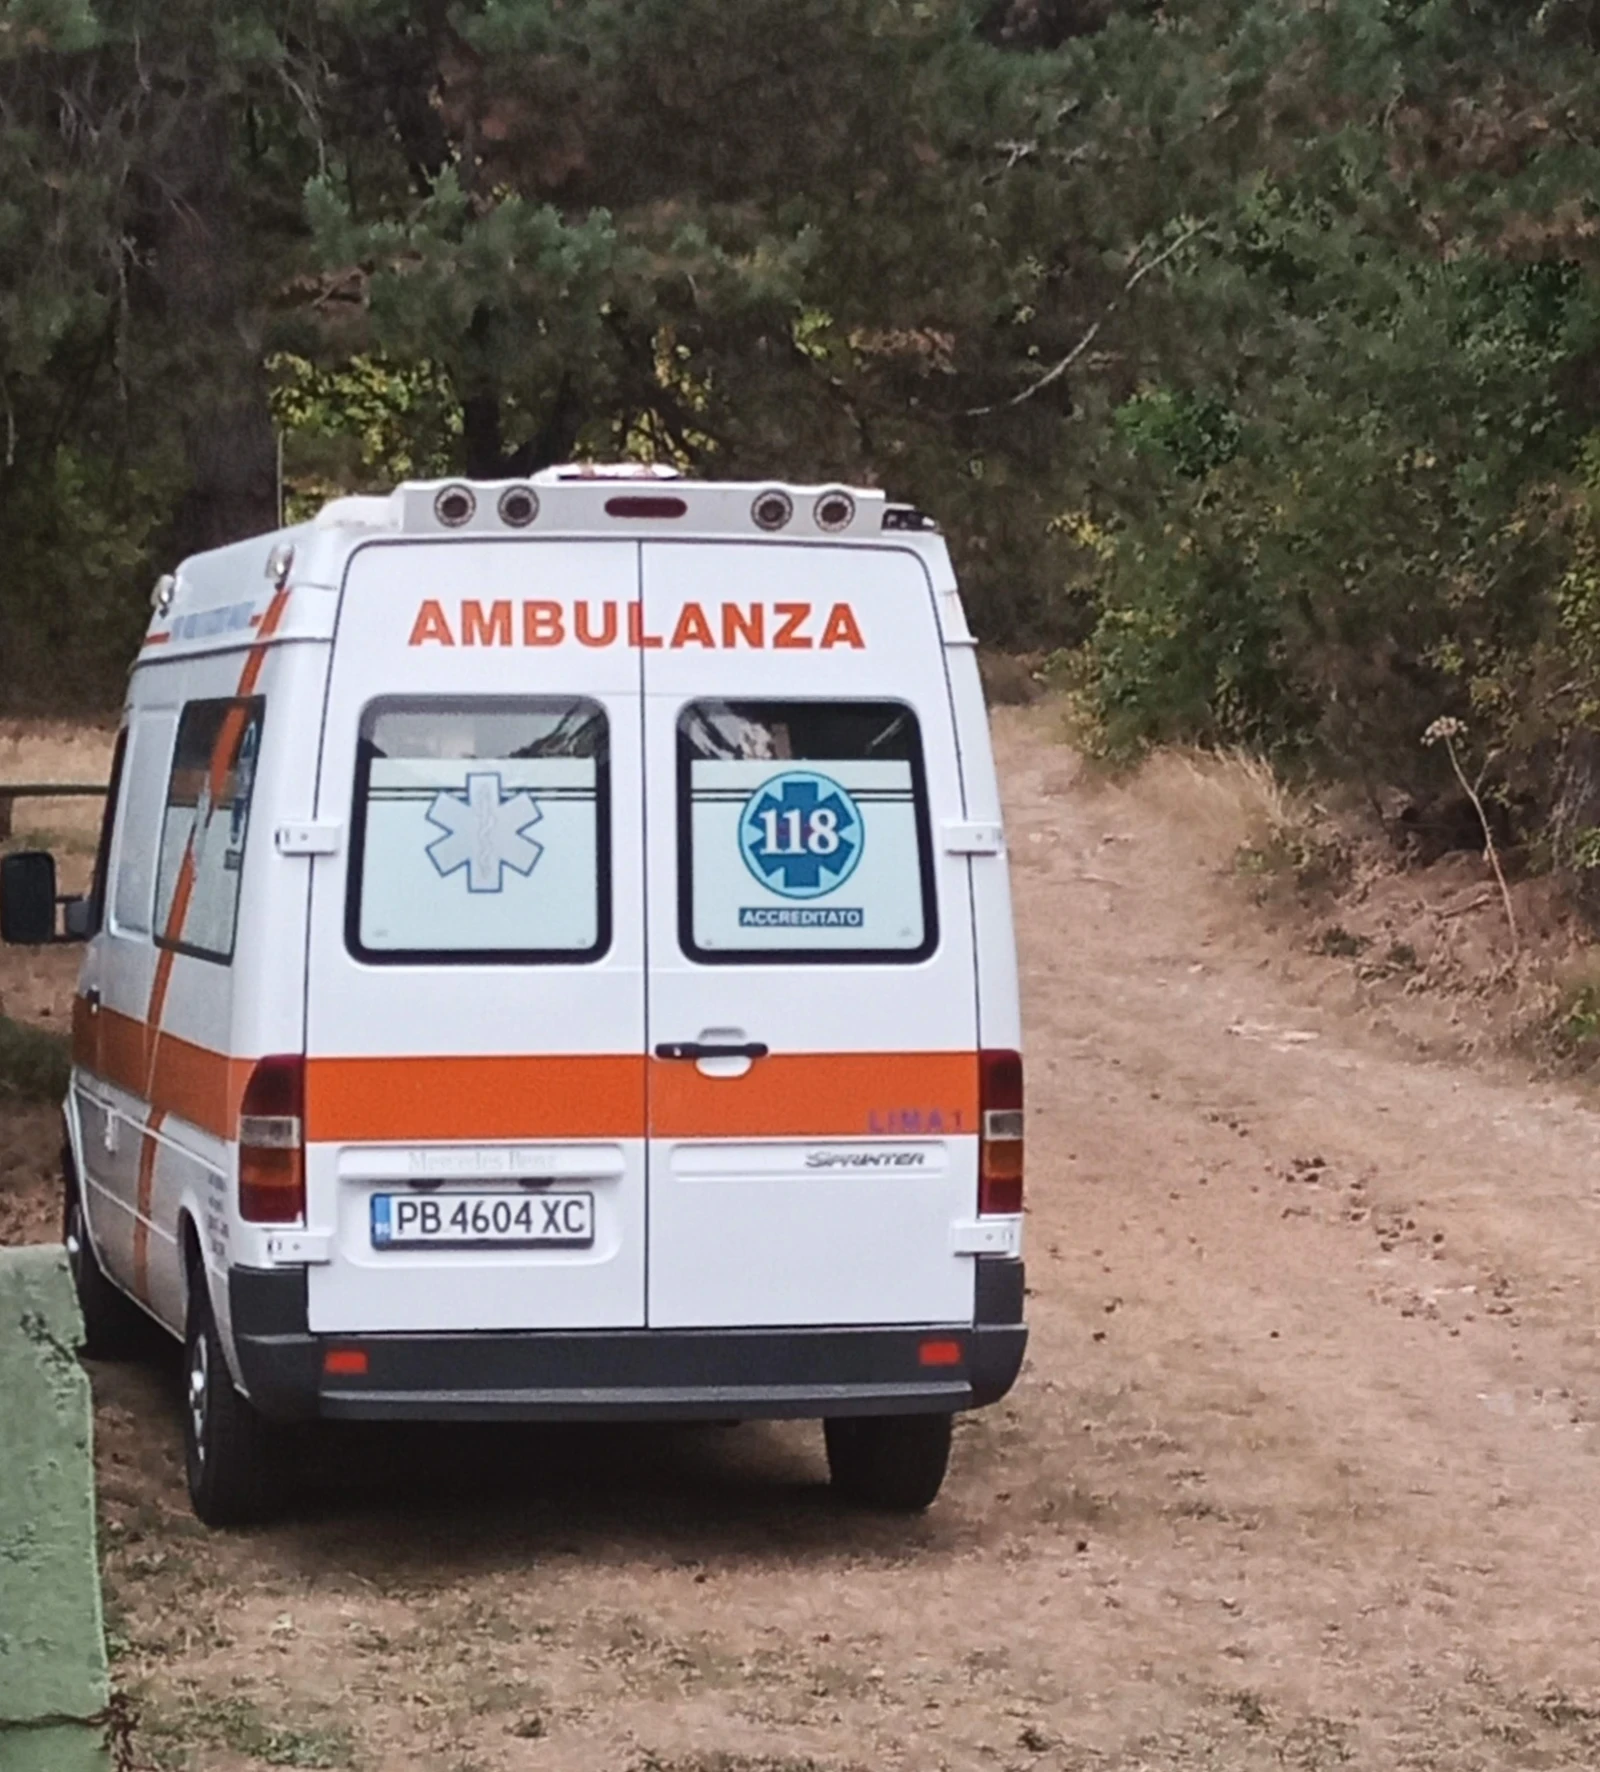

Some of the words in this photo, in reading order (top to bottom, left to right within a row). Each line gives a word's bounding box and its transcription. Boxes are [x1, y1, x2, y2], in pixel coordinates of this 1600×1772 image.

[407, 599, 866, 649] AMBULANZA
[758, 808, 839, 854] 118
[743, 911, 859, 924] ACCREDITATO
[397, 1201, 442, 1234] PB
[450, 1200, 533, 1234] 4604
[541, 1200, 585, 1234] XC
